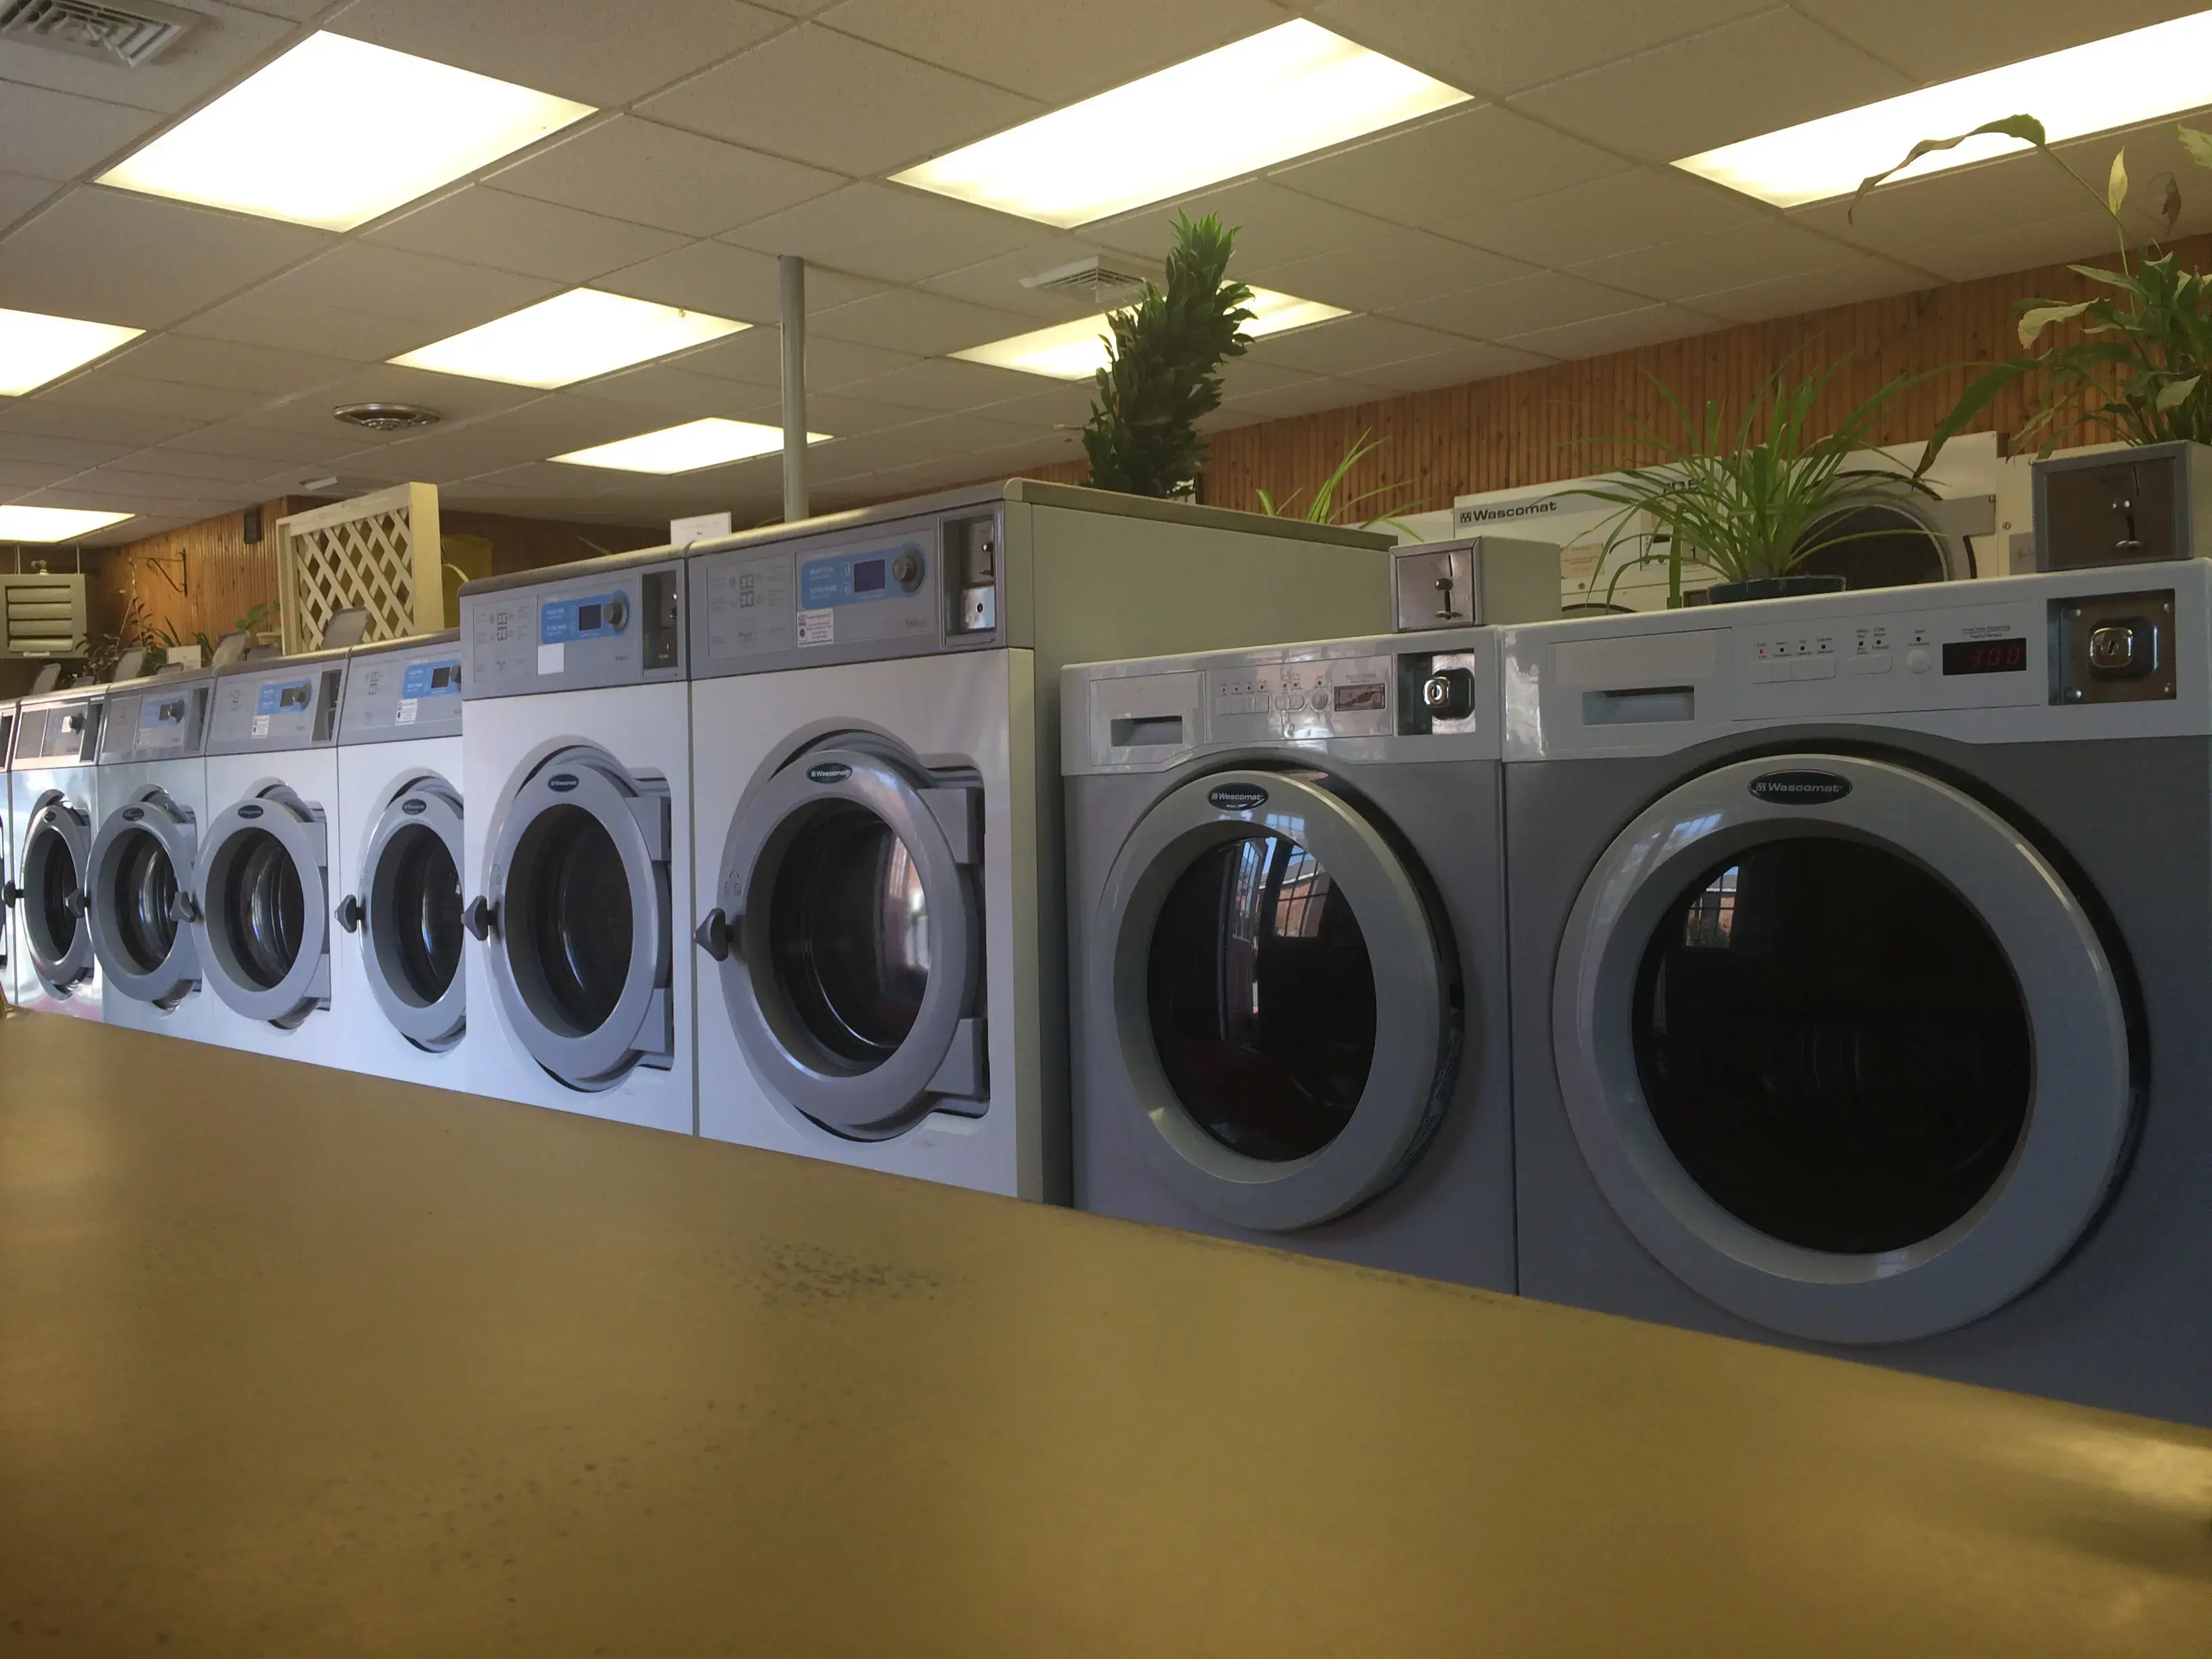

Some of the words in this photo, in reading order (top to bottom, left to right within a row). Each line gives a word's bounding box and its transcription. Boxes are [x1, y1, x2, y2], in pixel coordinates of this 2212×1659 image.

[1473, 501, 1557, 521] Wascomat
[1768, 783, 1839, 792] Wascomat
[1219, 792, 1261, 800] Wascomat
